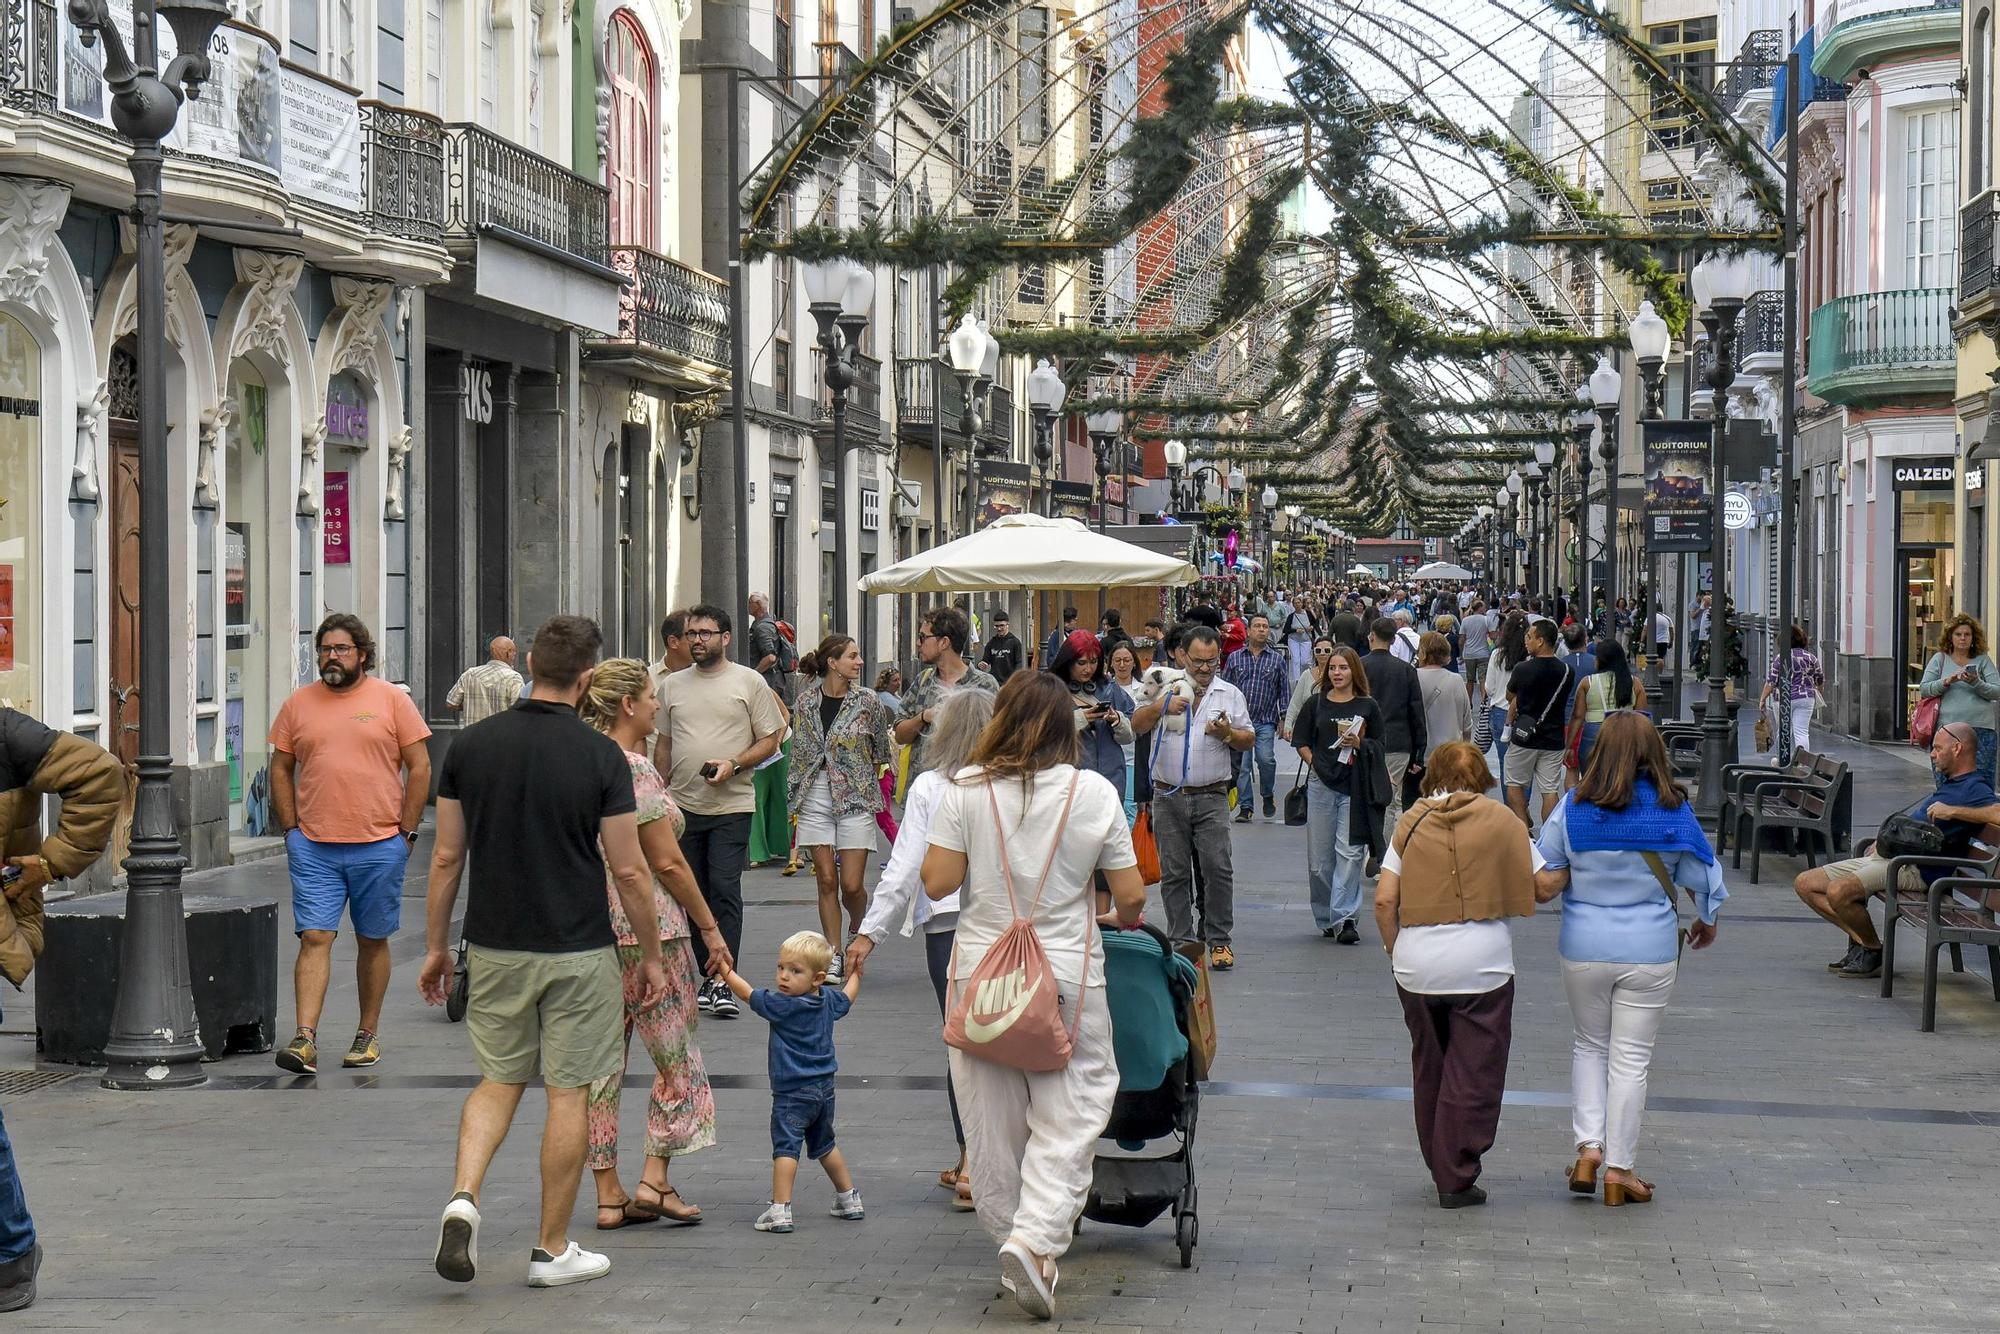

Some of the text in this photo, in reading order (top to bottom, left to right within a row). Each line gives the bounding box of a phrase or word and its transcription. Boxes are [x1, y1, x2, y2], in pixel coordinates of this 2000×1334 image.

[207, 34, 229, 56] 08
[1649, 441, 1708, 450] AUDITORIUM
[1895, 467, 1956, 482] CALZED
[983, 476, 1027, 486] AUDITORIUM
[1054, 493, 1091, 501] AUDITORIUM
[334, 507, 342, 516] 3
[335, 521, 342, 529] 3
